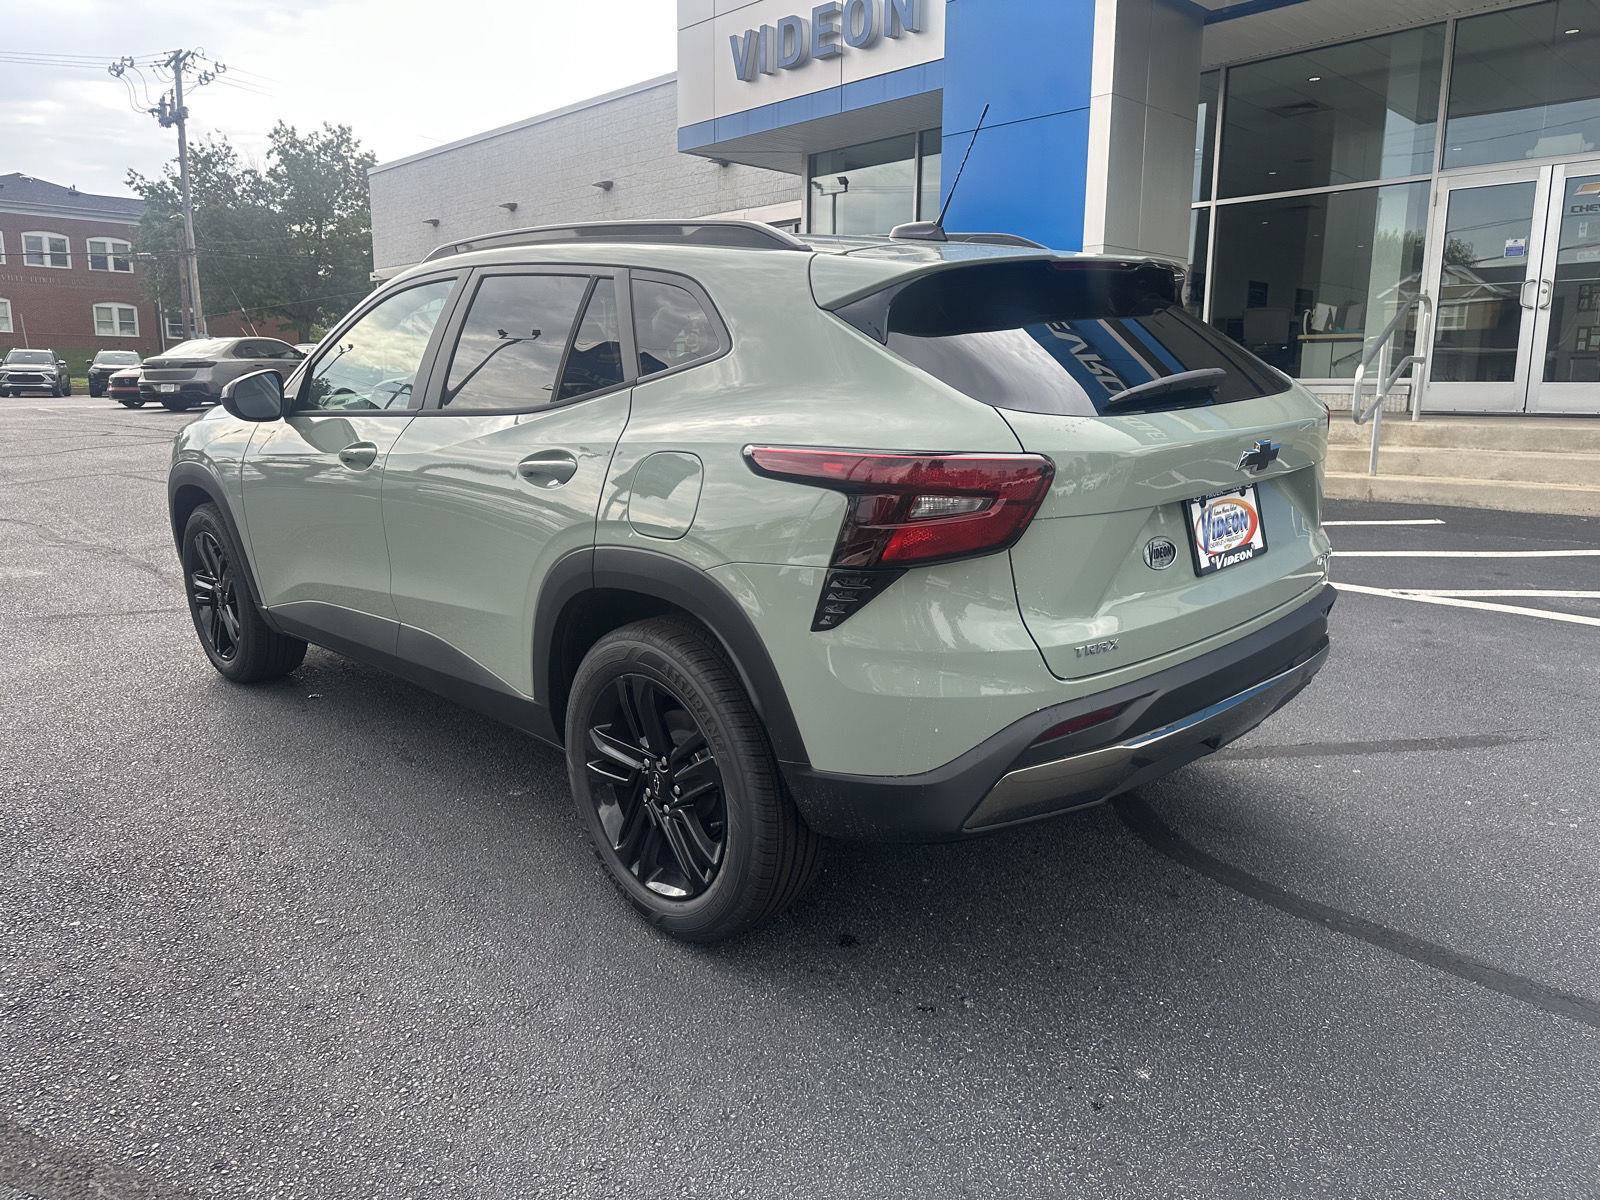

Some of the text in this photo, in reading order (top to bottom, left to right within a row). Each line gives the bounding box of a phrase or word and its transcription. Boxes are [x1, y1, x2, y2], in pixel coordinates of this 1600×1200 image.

[729, 0, 920, 82] VIDEON
[1201, 503, 1249, 556] VIDEON
[1148, 541, 1172, 567] VIDEON
[1215, 548, 1253, 570] VIDEON
[1074, 638, 1119, 658] TRAX
